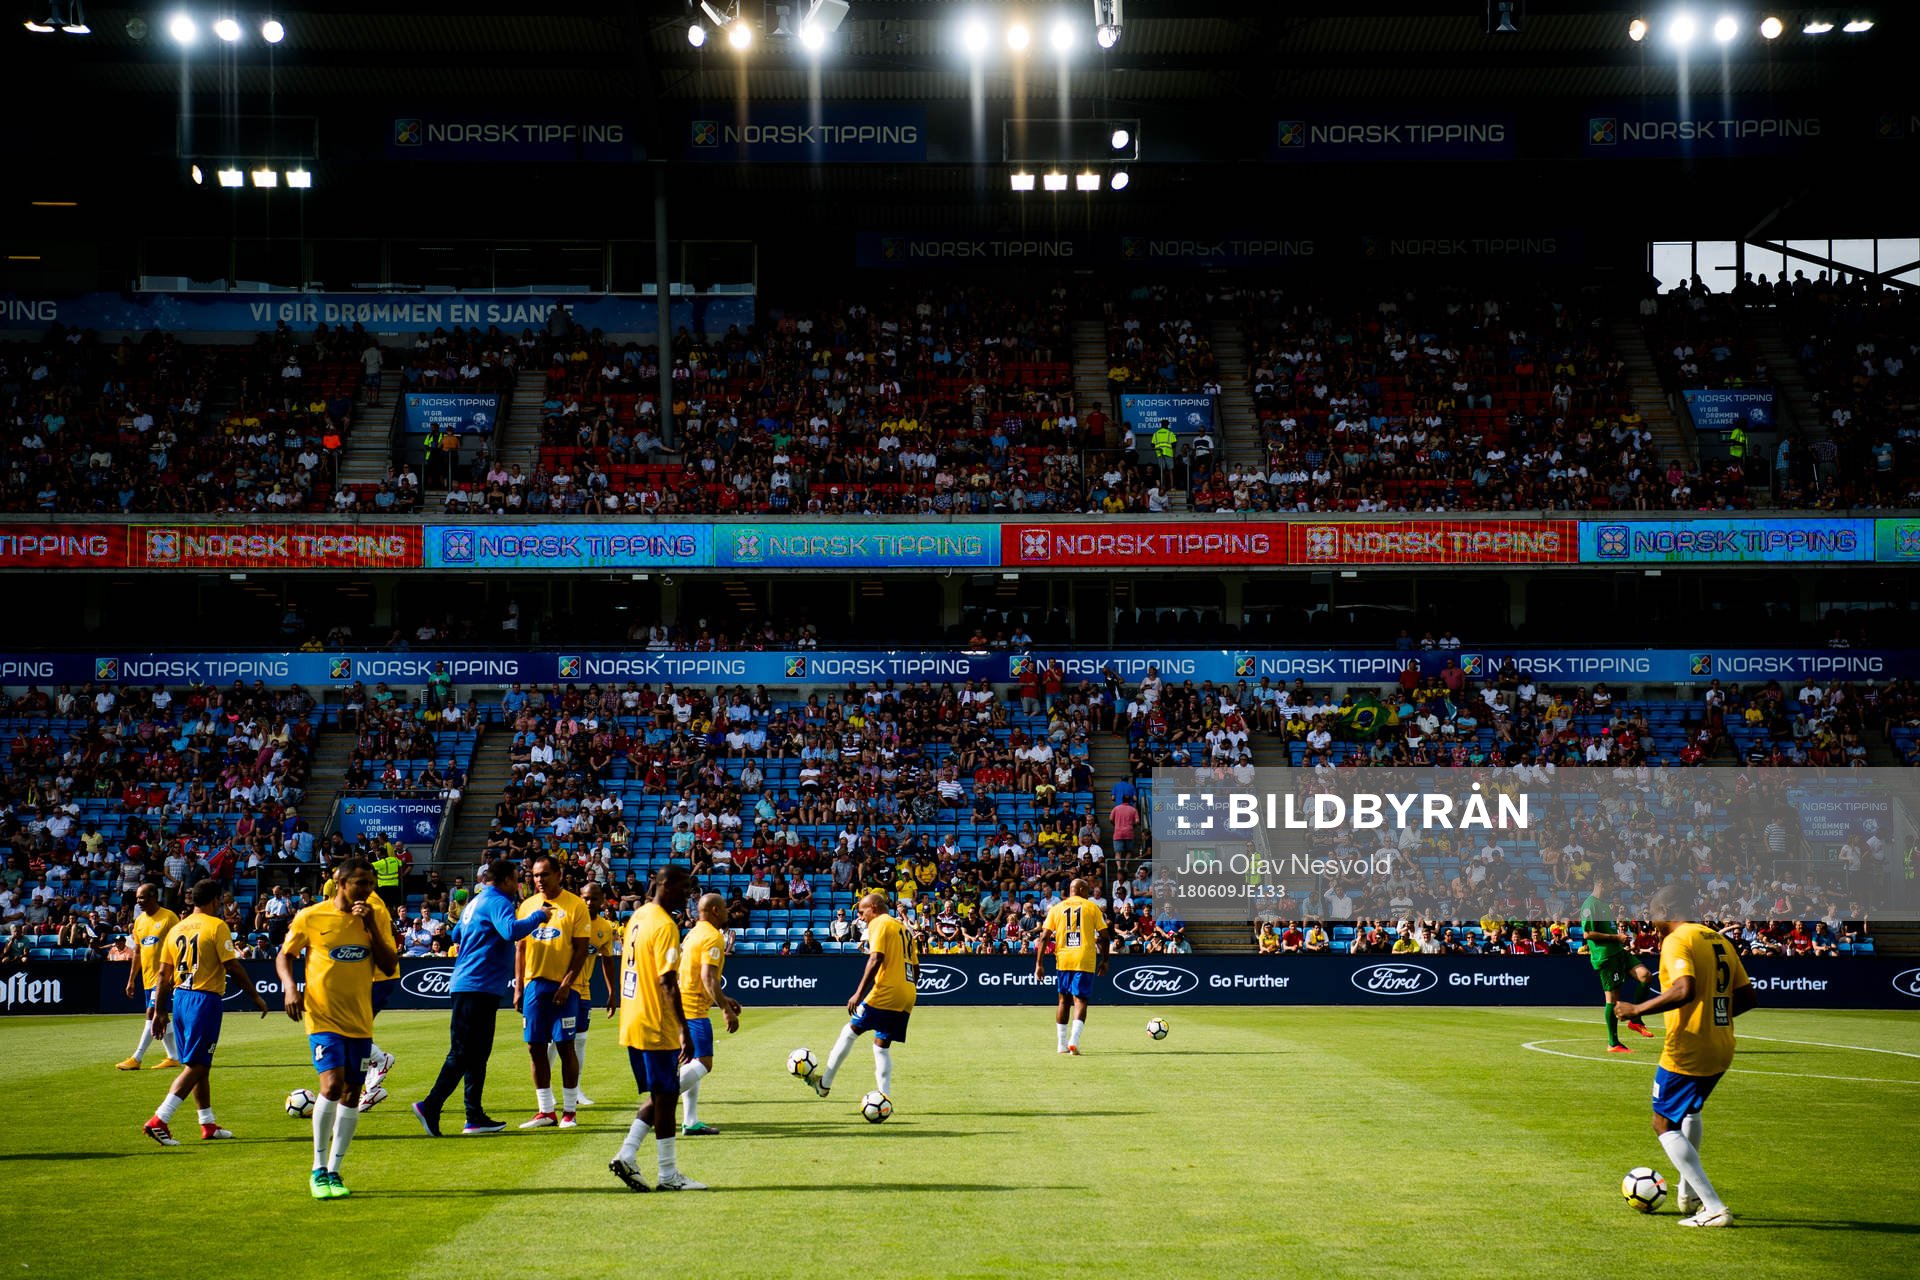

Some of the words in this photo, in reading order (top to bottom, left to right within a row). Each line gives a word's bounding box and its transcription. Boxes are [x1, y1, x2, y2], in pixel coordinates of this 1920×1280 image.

[428, 123, 519, 142] NORSK
[724, 126, 816, 144] NORSK
[818, 125, 918, 144] TIPPING
[1311, 125, 1401, 143] NORSK
[1404, 124, 1504, 142] TIPPING
[1623, 121, 1716, 141] NORSK
[1718, 118, 1822, 137] TIPPING
[909, 241, 985, 257] NORSK
[990, 241, 1073, 257] TIPPING
[1150, 240, 1226, 256] NORSK
[1229, 240, 1314, 256] TIPPING
[1390, 239, 1468, 255] NORSK
[1470, 238, 1557, 254] TIPPING
[250, 303, 271, 321] VI
[279, 303, 317, 321] GIR
[325, 303, 442, 323] DRØMMEN
[450, 304, 480, 323] EN
[1137, 399, 1172, 407] NORSK
[1698, 394, 1732, 402] NORSK
[1734, 394, 1773, 402] TIPPING
[0, 535, 108, 556] TIPPING
[185, 535, 289, 557] NORSK
[292, 535, 405, 557] TIPPING
[479, 536, 581, 557] NORSK
[584, 535, 697, 557] TIPPING
[769, 535, 870, 556] NORSK
[872, 535, 982, 556] TIPPING
[1056, 534, 1156, 555] NORSK
[1160, 534, 1270, 554] TIPPING
[1343, 532, 1443, 553] NORSK
[1447, 531, 1560, 553] TIPPING
[1634, 531, 1738, 552] NORSK
[1740, 531, 1857, 552] TIPPING
[124, 662, 200, 677] NORSK
[204, 662, 288, 677] TIPPING
[357, 661, 432, 676] NORSK
[585, 660, 660, 675] NORSK
[663, 660, 746, 675] TIPPING
[811, 660, 885, 675] NORSK
[889, 660, 970, 675] TIPPING
[1261, 659, 1335, 674] NORSK
[1489, 658, 1563, 673] NRSK
[1567, 658, 1650, 673] TIPPING
[1718, 657, 1794, 672] NORSK
[1797, 657, 1883, 672] TIPPING
[358, 805, 398, 814] NORSK
[399, 805, 441, 813] TIPPING
[1803, 803, 1842, 811] NORSK
[1844, 803, 1887, 811] TIPPING
[1064, 907, 1081, 930] 11
[176, 933, 200, 971] 21
[337, 948, 365, 959] Ford
[1712, 943, 1730, 993] 5
[738, 976, 759, 989] Go
[762, 975, 818, 989] Further
[979, 973, 999, 985] Go
[1129, 969, 1182, 991] Ford
[1210, 974, 1231, 987] Go
[1234, 974, 1290, 987] Further
[1367, 967, 1421, 990] Ford
[1449, 973, 1471, 986] Go
[1474, 973, 1530, 986] Further
[1770, 977, 1828, 990] Further
[255, 981, 278, 993] Go
